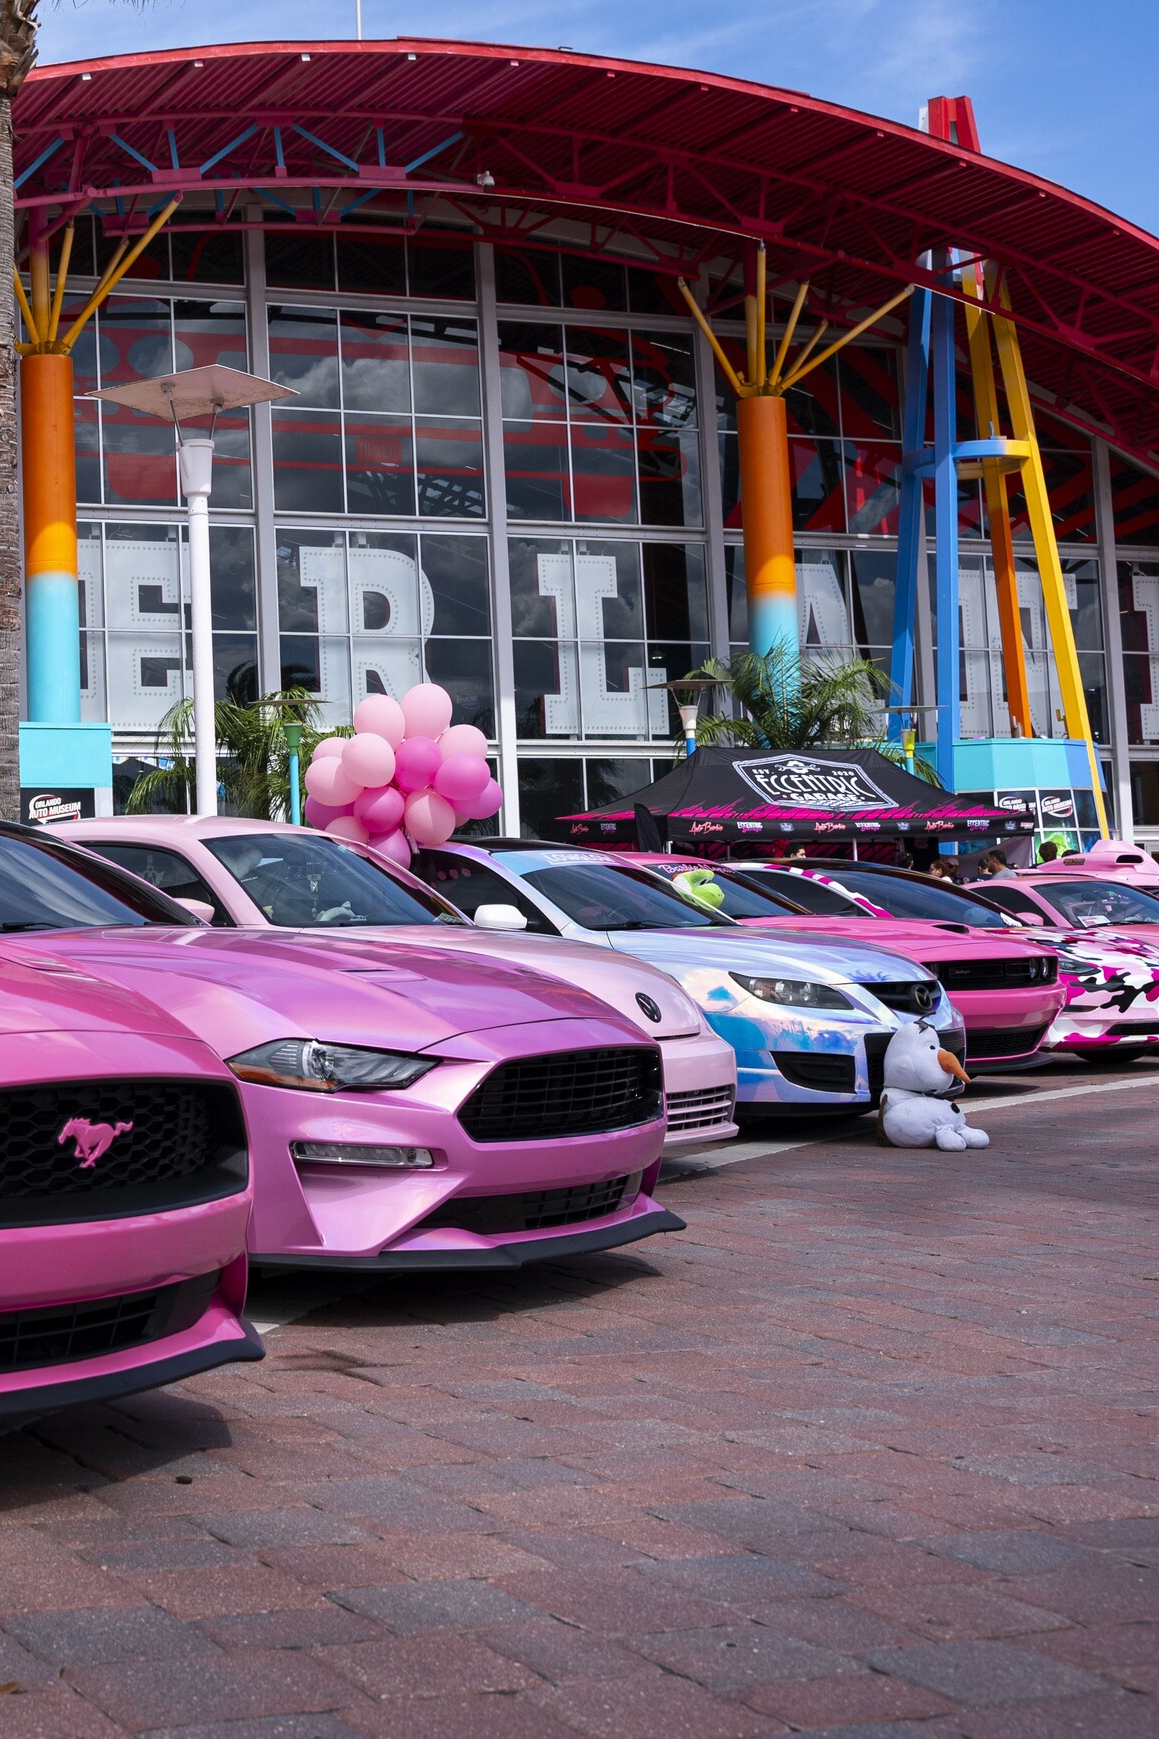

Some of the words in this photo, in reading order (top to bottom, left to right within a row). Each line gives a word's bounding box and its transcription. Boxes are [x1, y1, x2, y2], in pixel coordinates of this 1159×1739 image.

[754, 774, 877, 798] ECCENTRIC
[35, 797, 62, 809] ORLANDO
[790, 793, 859, 802] GARAGE
[29, 808, 48, 820] AUTO
[49, 801, 81, 816] MUSEUM
